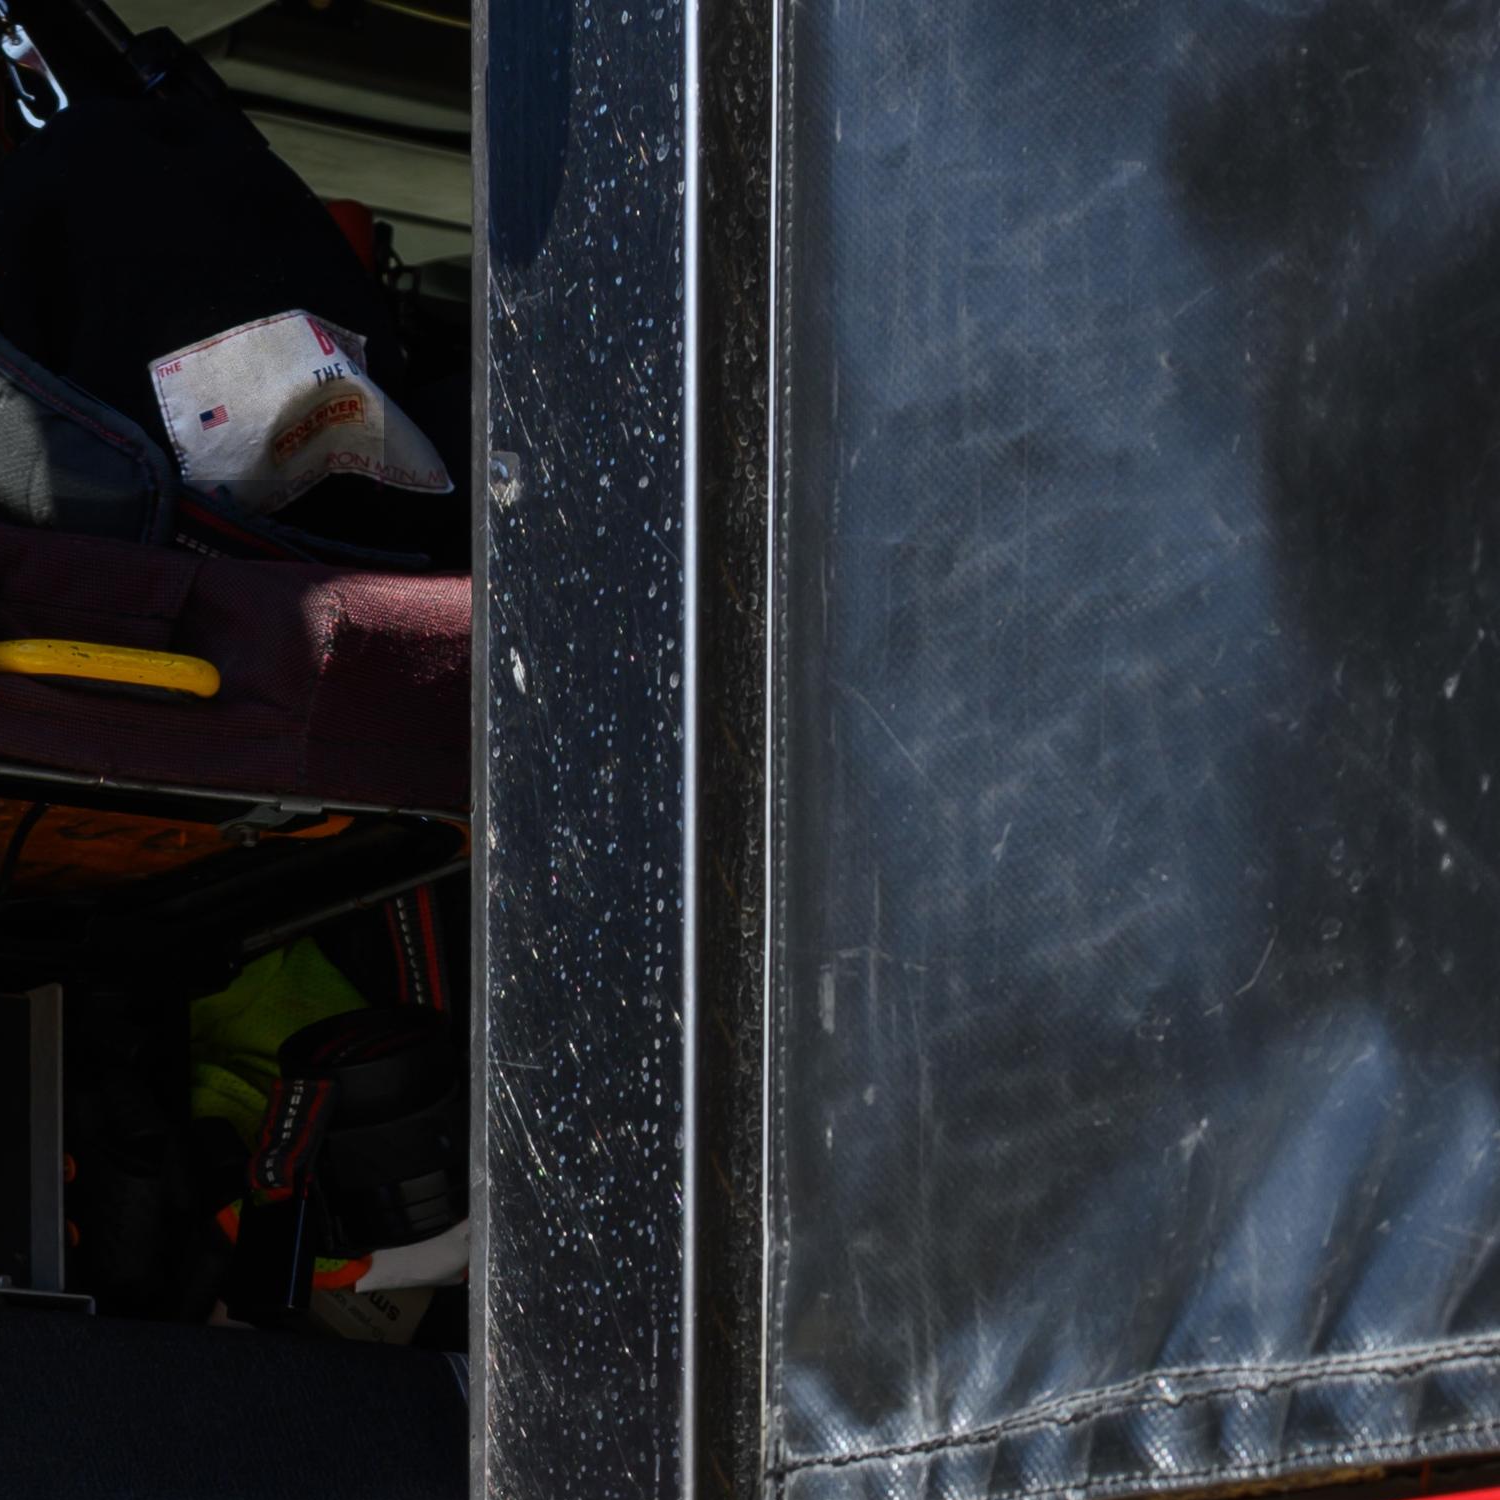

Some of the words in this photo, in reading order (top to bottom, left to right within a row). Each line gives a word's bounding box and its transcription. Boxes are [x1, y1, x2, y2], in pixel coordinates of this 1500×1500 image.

[158, 361, 183, 378] THE
[312, 362, 346, 388] THE
[315, 399, 359, 424] RIVER
